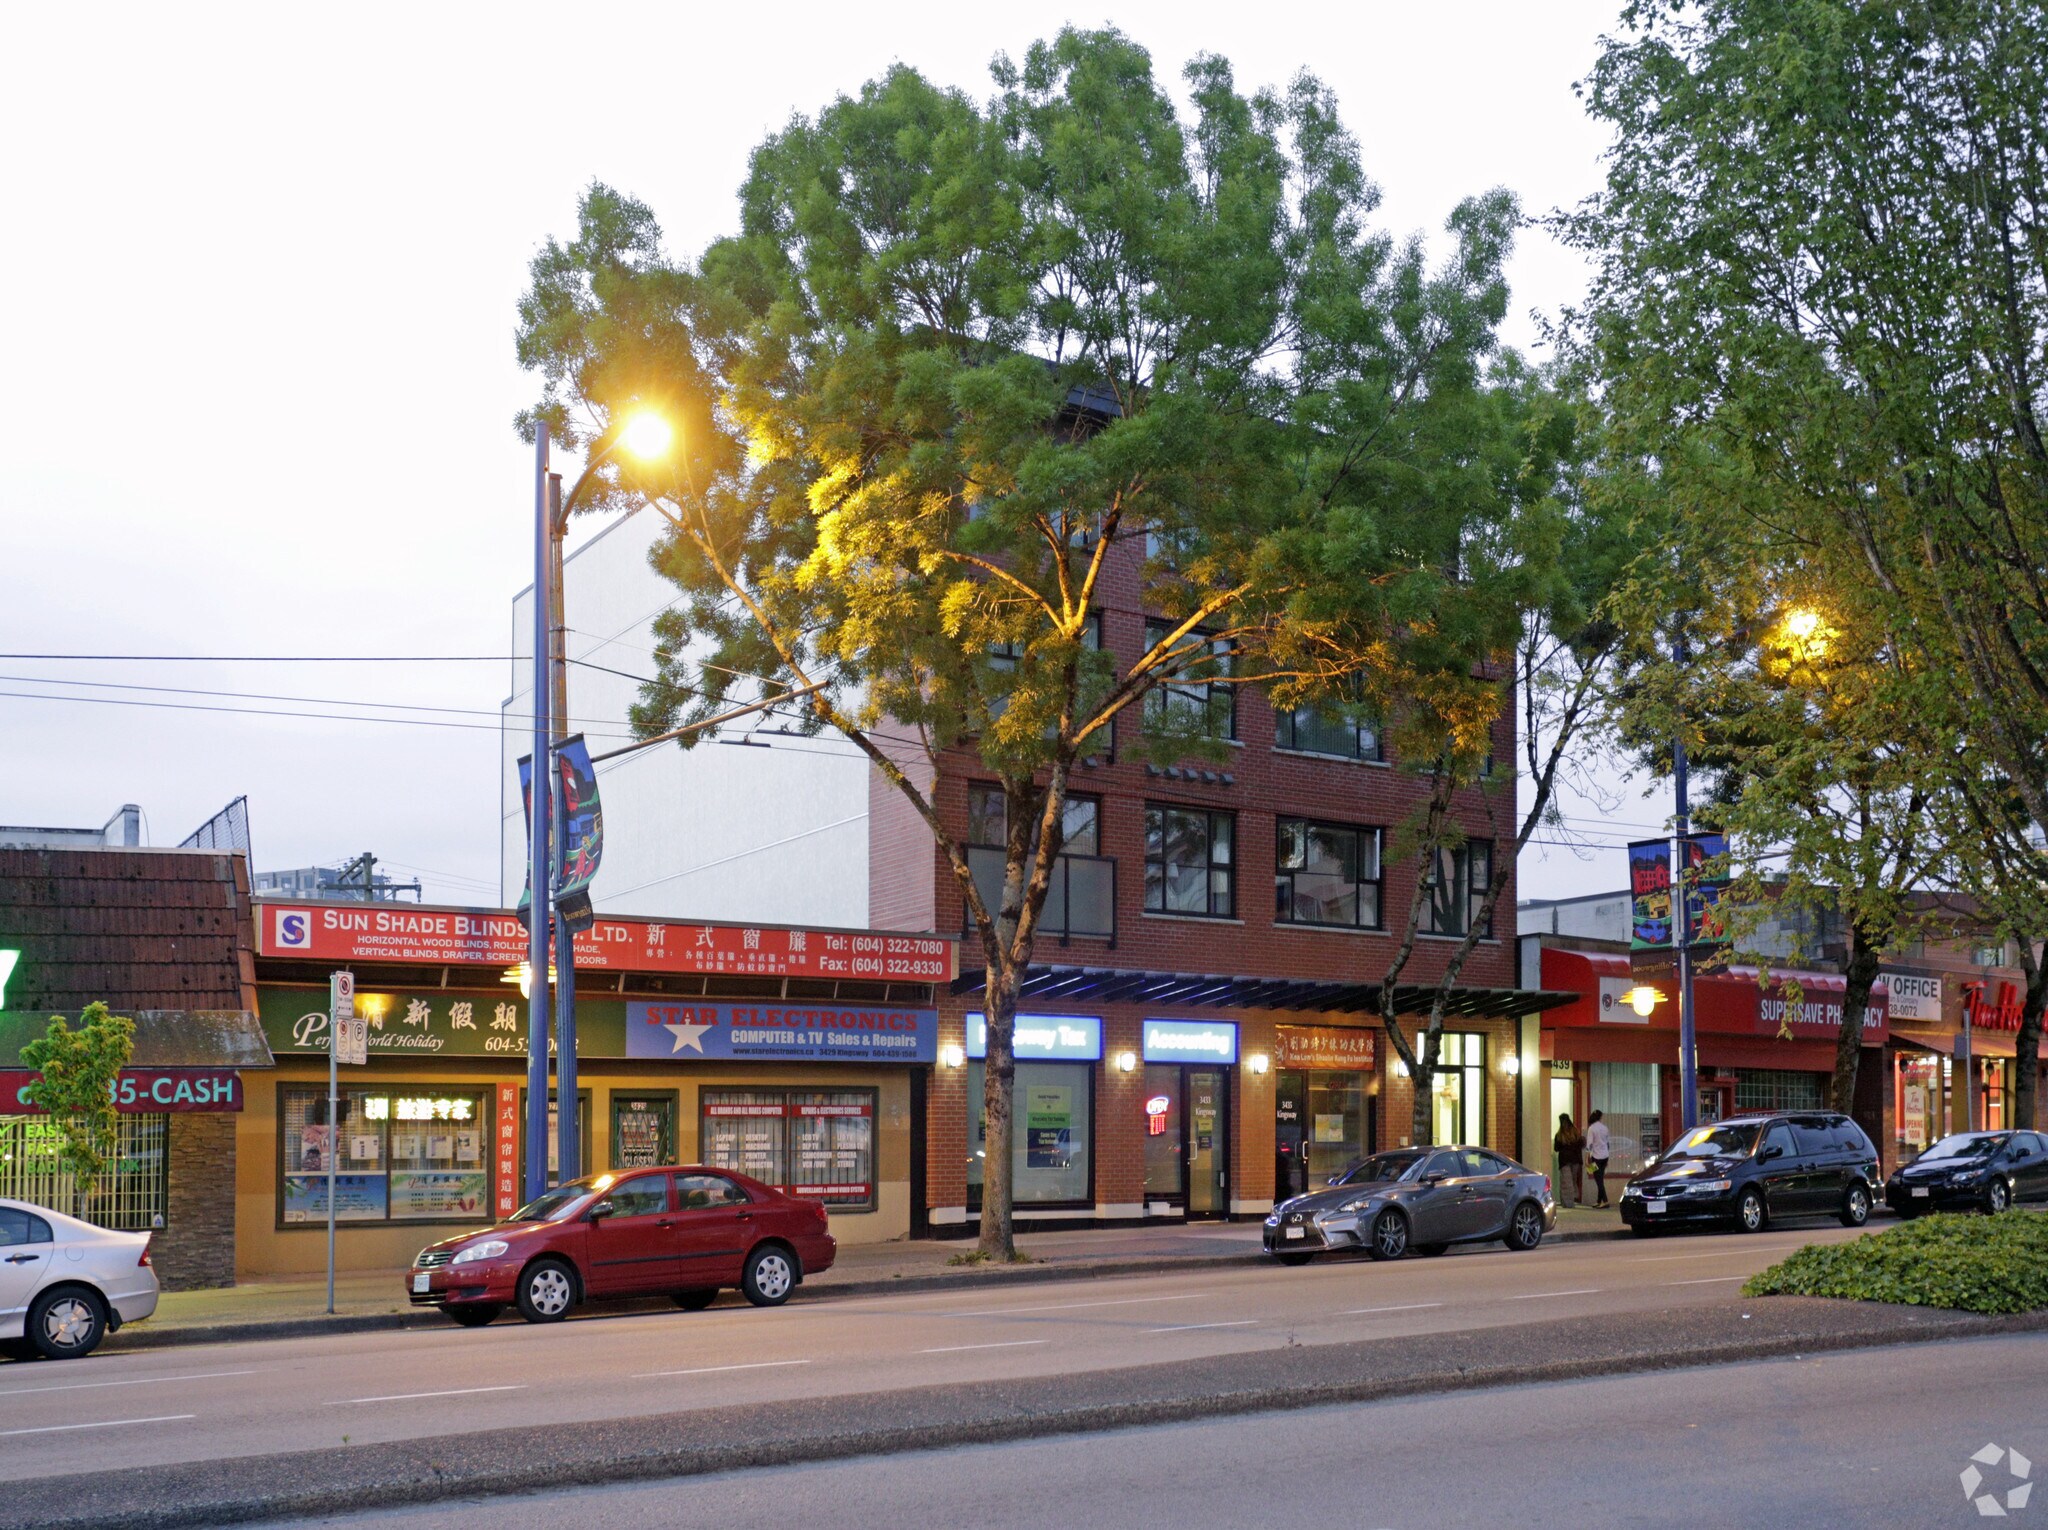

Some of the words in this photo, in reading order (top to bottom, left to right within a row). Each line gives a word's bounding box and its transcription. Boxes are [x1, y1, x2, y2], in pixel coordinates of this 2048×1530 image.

[323, 909, 368, 930] SUN
[376, 912, 447, 934] SHADE
[454, 916, 529, 938] BLINDS
[591, 923, 633, 943] LTD.
[357, 936, 421, 946] HORIZONTAL
[422, 939, 453, 948] WOOD
[824, 935, 848, 950] Tel:
[852, 936, 884, 956] (604)
[887, 939, 944, 955] 322-7080
[352, 947, 401, 957] VERTICAL
[576, 956, 608, 965] DOORS
[819, 956, 848, 971] Fax:
[852, 958, 884, 976] (604)
[886, 959, 944, 975] 322-9330
[1894, 977, 1938, 998] OFFICE
[646, 1007, 719, 1026] STAR
[731, 1008, 917, 1031] ELECTRONICS
[1826, 1004, 1884, 1028] PHACY
[1889, 1004, 1918, 1017] 38-0072
[367, 1034, 396, 1047] orld
[394, 1034, 444, 1051] Holiday
[731, 1030, 795, 1045] COMPUTER
[797, 1032, 806, 1045] &
[808, 1032, 823, 1045] TV
[828, 1032, 860, 1047] Sales
[862, 1035, 870, 1046] &
[872, 1033, 917, 1048] Repairs
[1058, 1026, 1087, 1046] Tax
[1148, 1028, 1230, 1055] Accounting
[1196, 1107, 1217, 1118] Kingsway
[1276, 1110, 1298, 1120] Kingsway
[26, 1160, 57, 1174] BAD
[120, 1158, 141, 1172] OK
